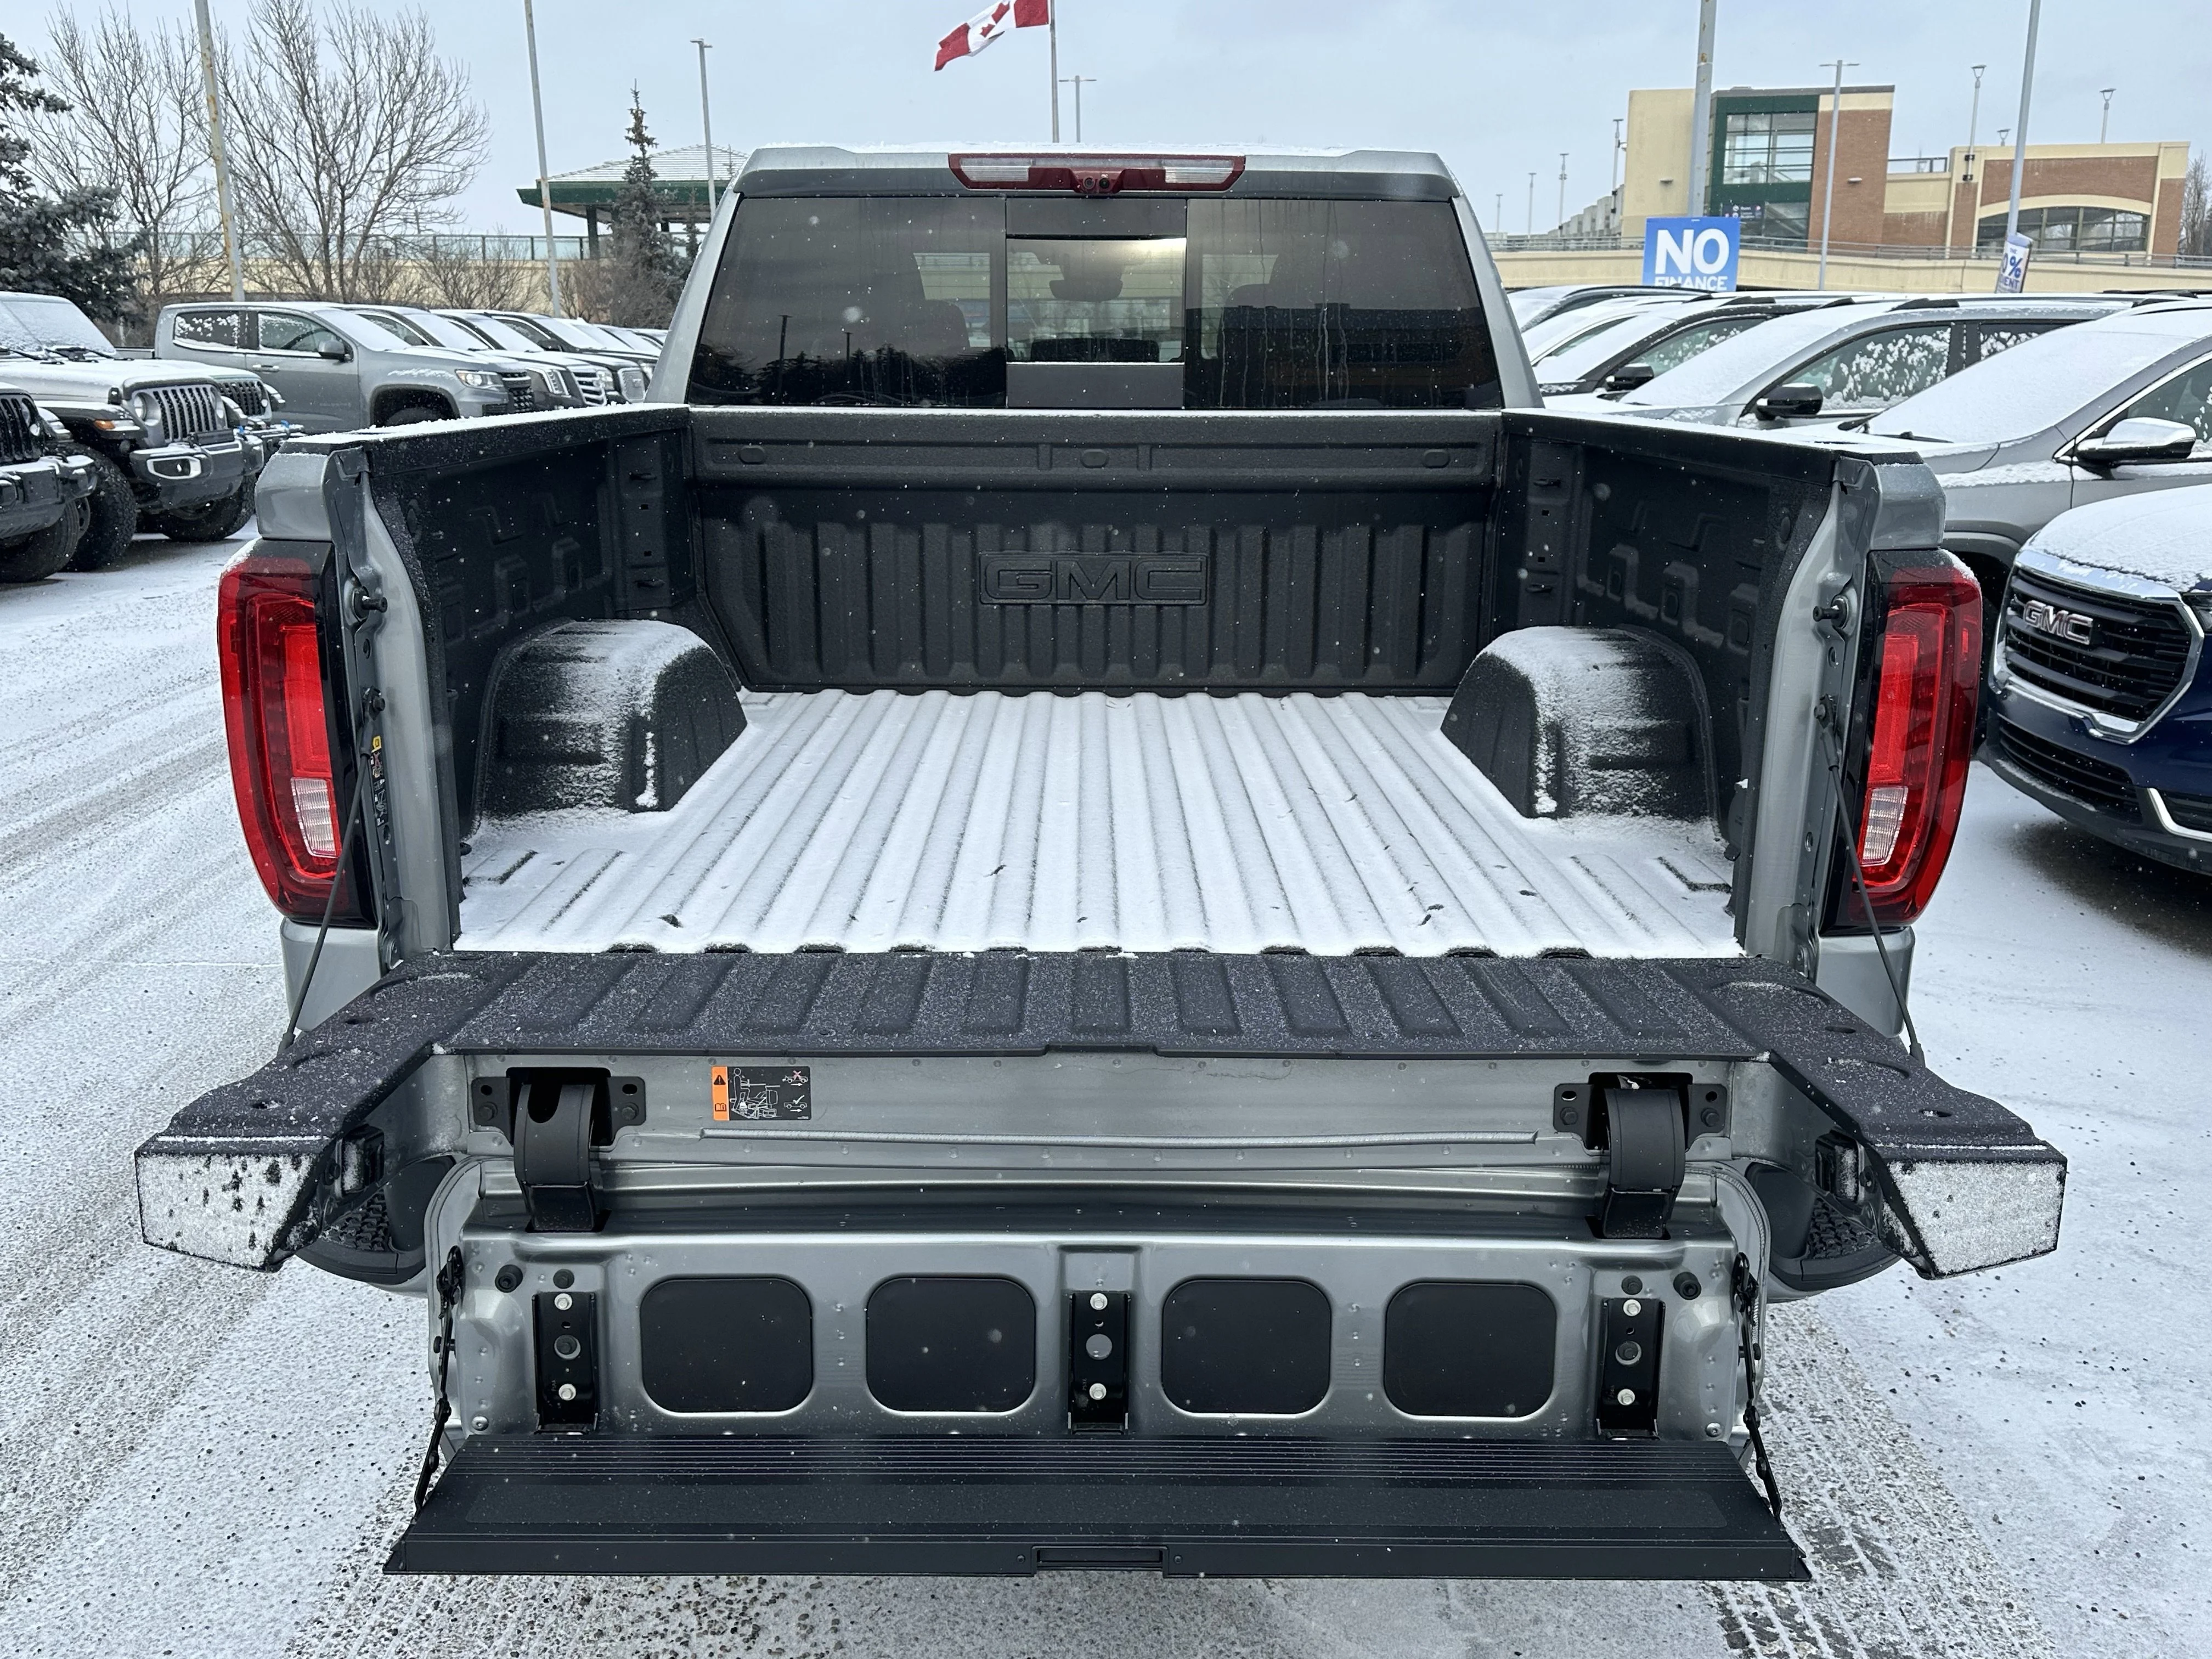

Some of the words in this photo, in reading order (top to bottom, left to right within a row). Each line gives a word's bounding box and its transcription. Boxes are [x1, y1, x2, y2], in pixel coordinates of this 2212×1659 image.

[1655, 228, 1730, 274] NO
[1655, 276, 1728, 290] FINANCE
[984, 559, 1203, 601] GMC
[2024, 600, 2094, 645] GMC
